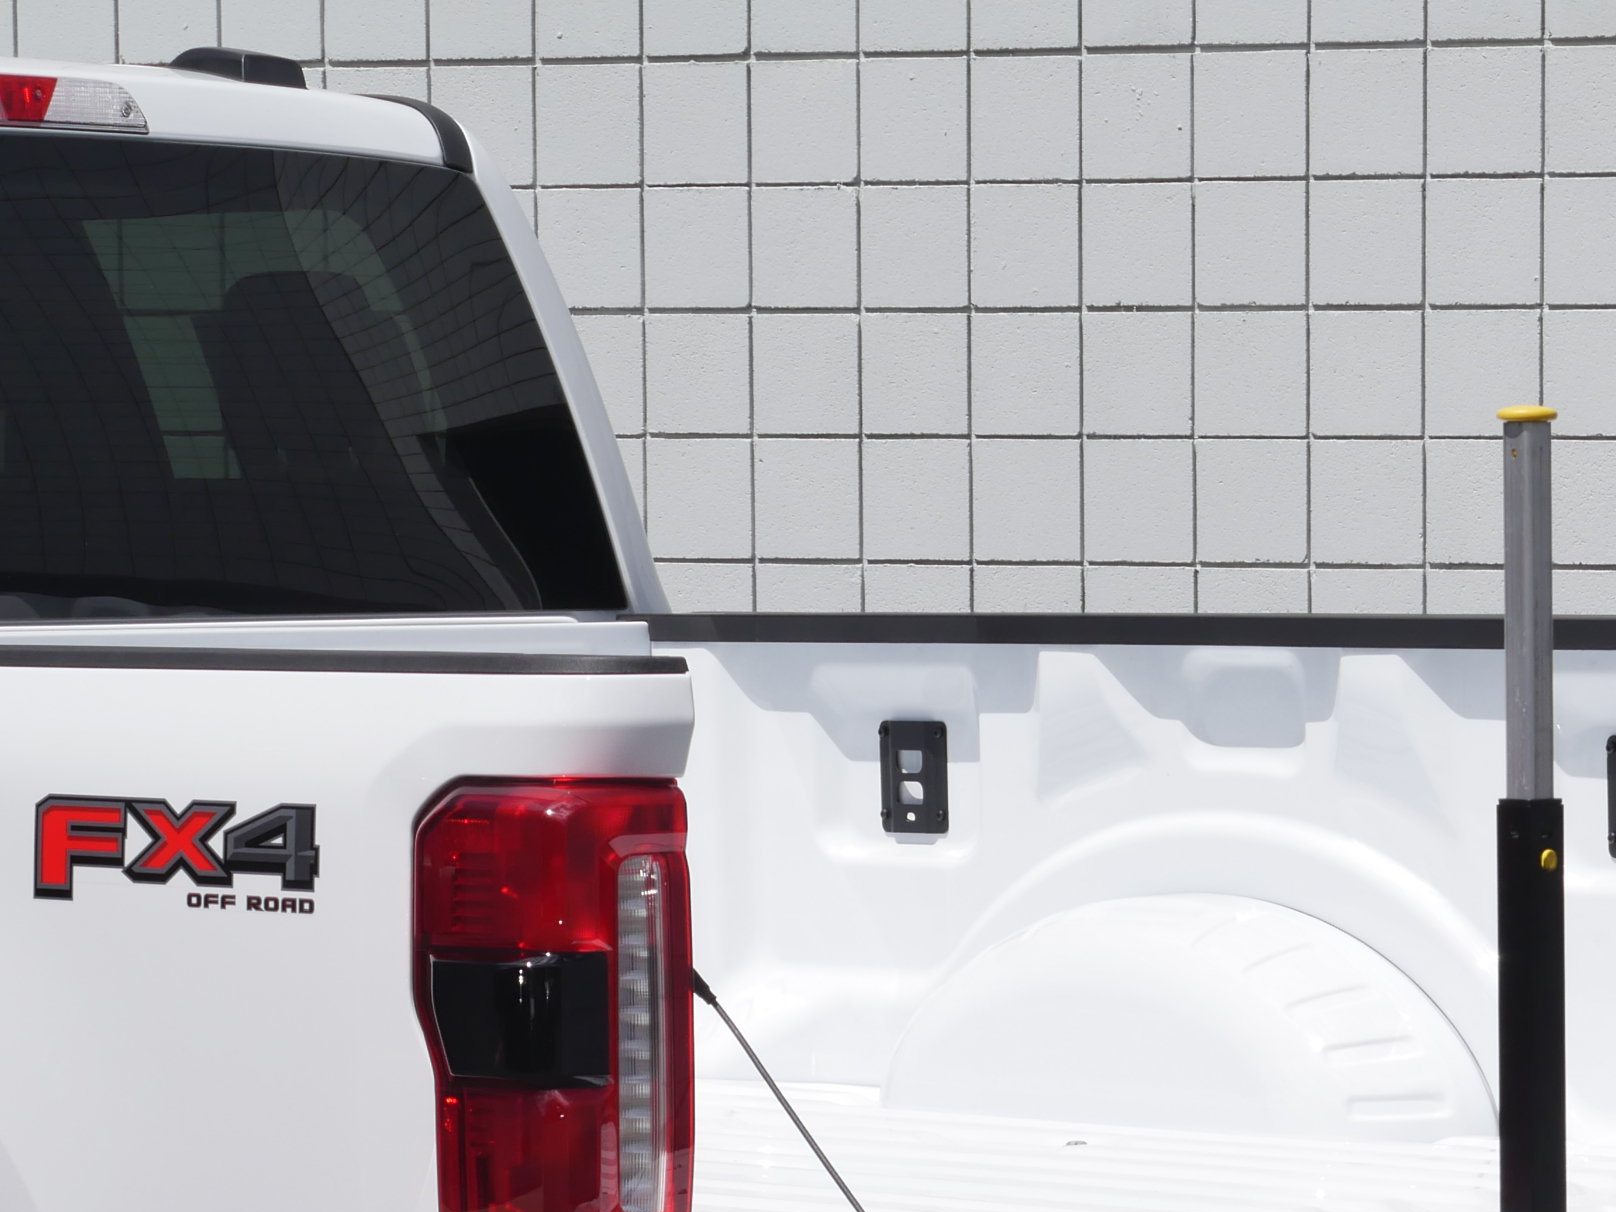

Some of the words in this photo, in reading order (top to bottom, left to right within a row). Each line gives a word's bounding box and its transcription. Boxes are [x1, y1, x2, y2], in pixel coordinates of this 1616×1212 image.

[33, 793, 320, 901] FX4
[186, 892, 236, 910] OFF
[246, 895, 315, 914] ROAD
